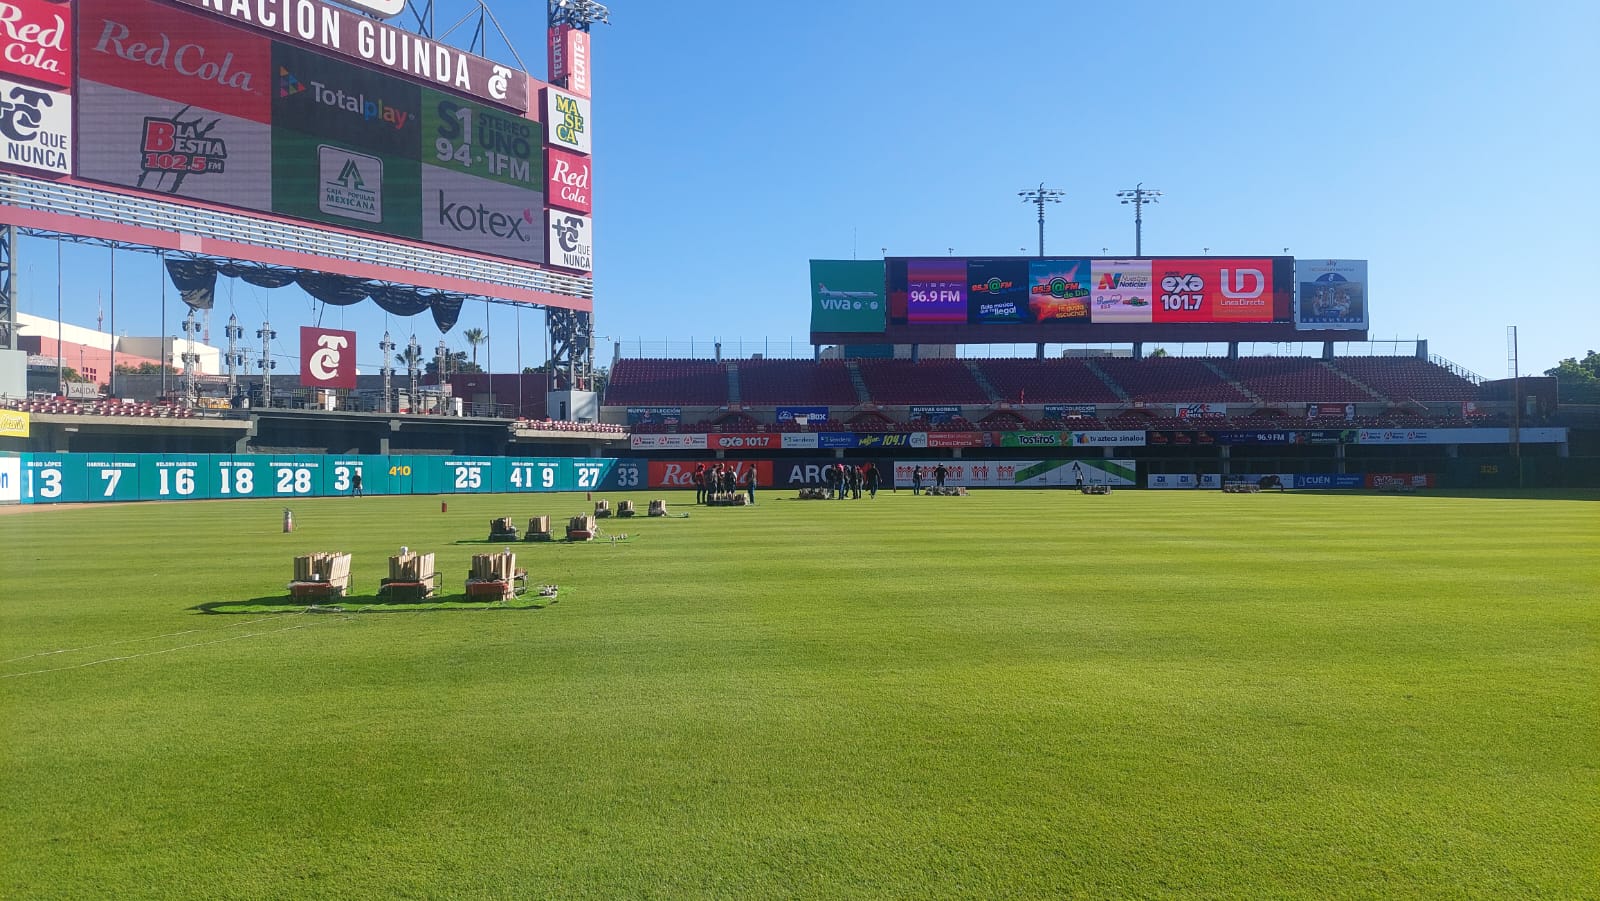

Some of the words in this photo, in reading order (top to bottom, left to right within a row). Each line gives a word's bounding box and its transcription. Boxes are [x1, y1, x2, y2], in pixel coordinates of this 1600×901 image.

[0, 3, 68, 52] Red
[4, 43, 59, 73] Cola
[94, 18, 170, 71] Red
[174, 43, 256, 92] Cola
[357, 20, 471, 91] GUINDA
[553, 35, 562, 78] TECATE
[573, 41, 586, 91] TECATE
[310, 80, 408, 130] Totalplay
[176, 122, 196, 138] LA
[478, 112, 530, 139] STEREO
[40, 131, 68, 150] QUE
[478, 126, 530, 160] UNO
[8, 142, 68, 170] NUNCA
[144, 154, 207, 172] 102.5
[207, 161, 223, 171] FM
[552, 159, 589, 190] Red
[326, 187, 342, 196] CAJA
[561, 186, 586, 205] Cola
[326, 194, 376, 211] MEXICANA
[438, 189, 526, 243] kotex
[577, 244, 591, 256] QUE
[563, 252, 591, 269] NUNCA
[1161, 274, 1204, 292] exa
[911, 291, 937, 302] 96.9
[940, 291, 961, 303] FM
[1160, 294, 1204, 312] 101.7
[71, 383, 96, 395] SALIDA
[719, 436, 743, 448] exa
[744, 436, 769, 447] 101.7
[881, 434, 906, 446] 104.1
[1257, 433, 1273, 441] 96.9
[1273, 433, 1285, 441] FM
[220, 467, 254, 494] 18
[277, 468, 311, 493] 28
[389, 465, 411, 476] 410
[455, 466, 482, 489] 25
[510, 467, 532, 487] 41
[542, 467, 554, 488] 9
[578, 467, 600, 487] 27
[617, 467, 639, 487] 33
[1306, 476, 1330, 484] CUÉN
[27, 468, 62, 498] 13
[101, 469, 122, 497] 7
[159, 468, 195, 495] 16
